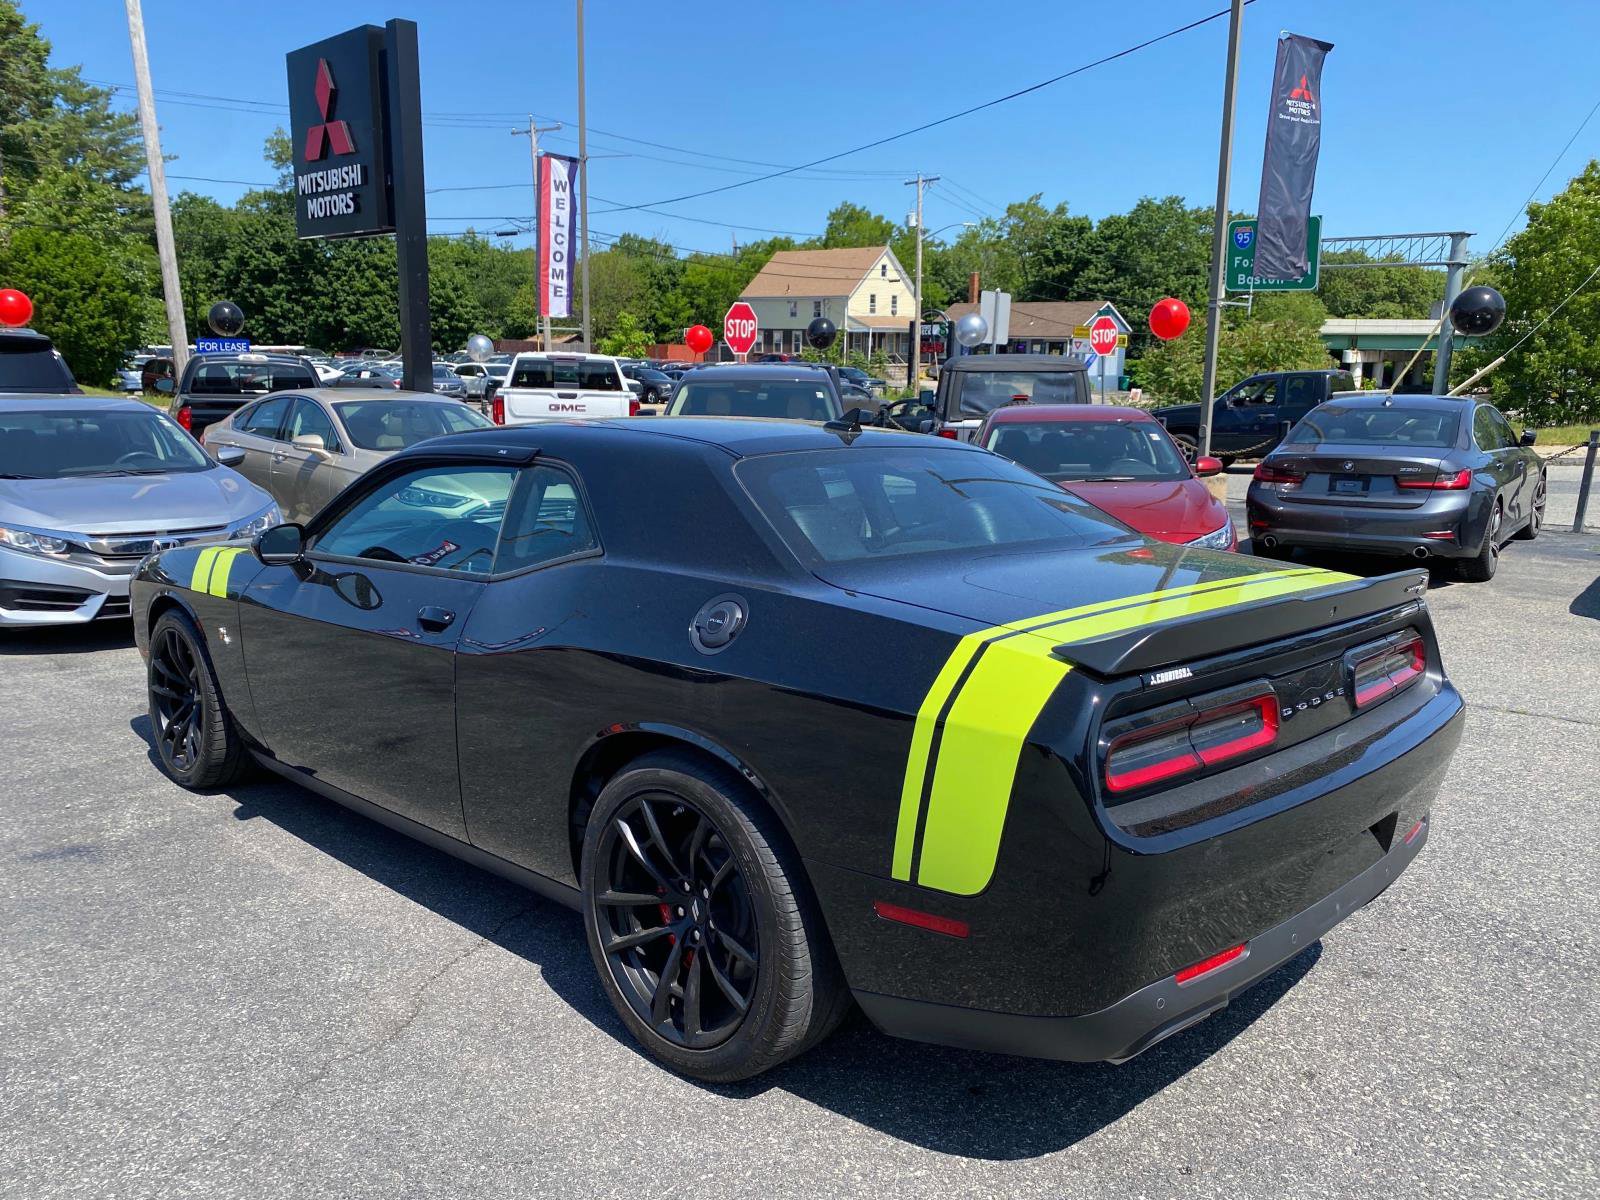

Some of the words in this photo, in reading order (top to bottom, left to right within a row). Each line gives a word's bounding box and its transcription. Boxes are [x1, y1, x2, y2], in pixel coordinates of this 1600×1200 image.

[1289, 107, 1310, 116] MOTORS
[298, 164, 361, 195] MITSUBISHI
[307, 192, 354, 219] MOTORS
[551, 179, 567, 298] WELCOME
[1237, 233, 1250, 243] 95
[727, 319, 755, 338] STOP
[1092, 329, 1116, 344] STOP
[199, 342, 217, 351] FOR
[220, 342, 247, 352] LEASE
[549, 404, 586, 412] GMC
[1282, 688, 1345, 716] DODGE
